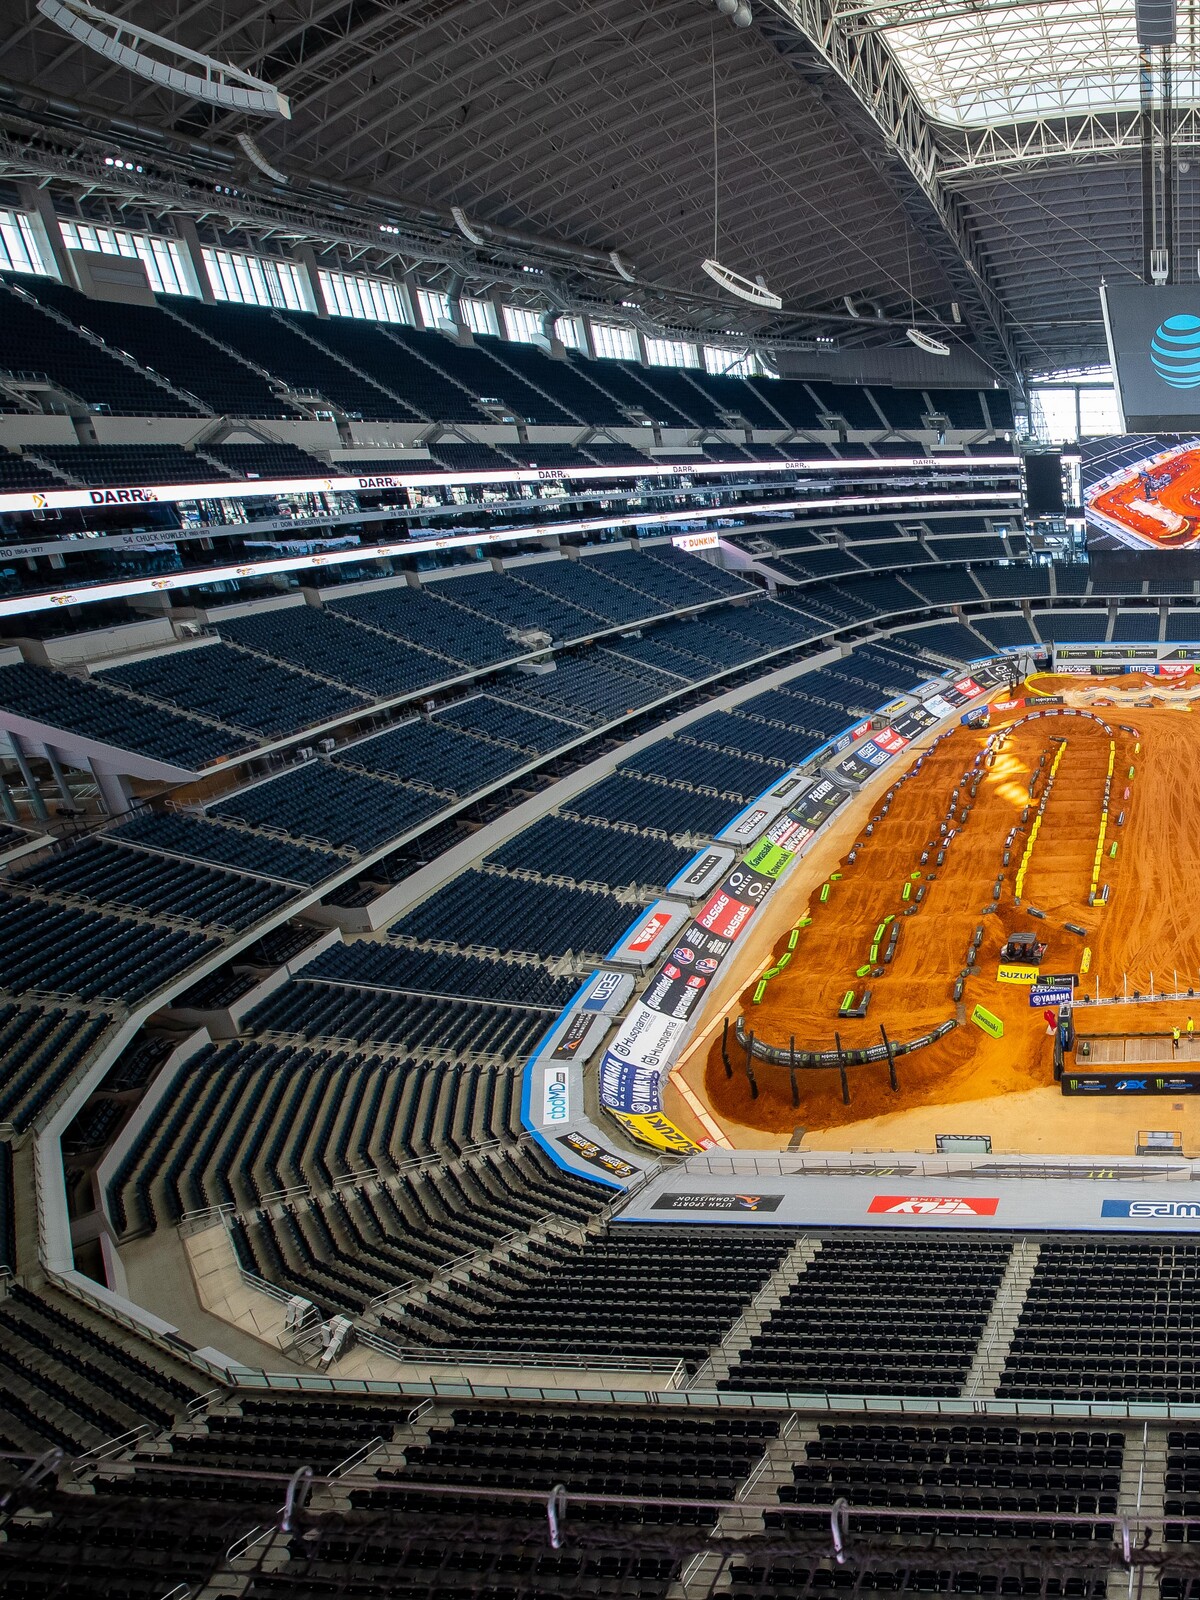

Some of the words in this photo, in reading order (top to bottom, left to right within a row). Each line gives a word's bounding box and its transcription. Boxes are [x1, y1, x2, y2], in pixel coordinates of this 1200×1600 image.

[136, 534, 160, 543] CHUCK
[160, 531, 187, 541] HOWLEY
[293, 518, 321, 527] MEREDITH
[689, 537, 718, 547] DUNKIN'
[749, 842, 774, 868] Kawasaki
[766, 852, 790, 876] Kawasaki
[702, 895, 729, 929] GASGAS
[723, 906, 750, 938] GASGAS
[632, 919, 661, 944] FLY
[1000, 971, 1036, 979] SUZUKI
[648, 973, 674, 1010] guaranteed
[672, 985, 698, 1019] guaranteed
[1041, 993, 1070, 1002] YAMAHA
[622, 1010, 650, 1047] Husqvarna
[973, 1010, 998, 1031] Kawasaki
[649, 1021, 677, 1057] Husqvarna
[603, 1058, 623, 1097] YAMAHA
[620, 1067, 629, 1106] RACING
[632, 1068, 653, 1102] YAMAHA
[547, 1083, 566, 1120] cbdMD
[884, 1201, 978, 1215] FLY
